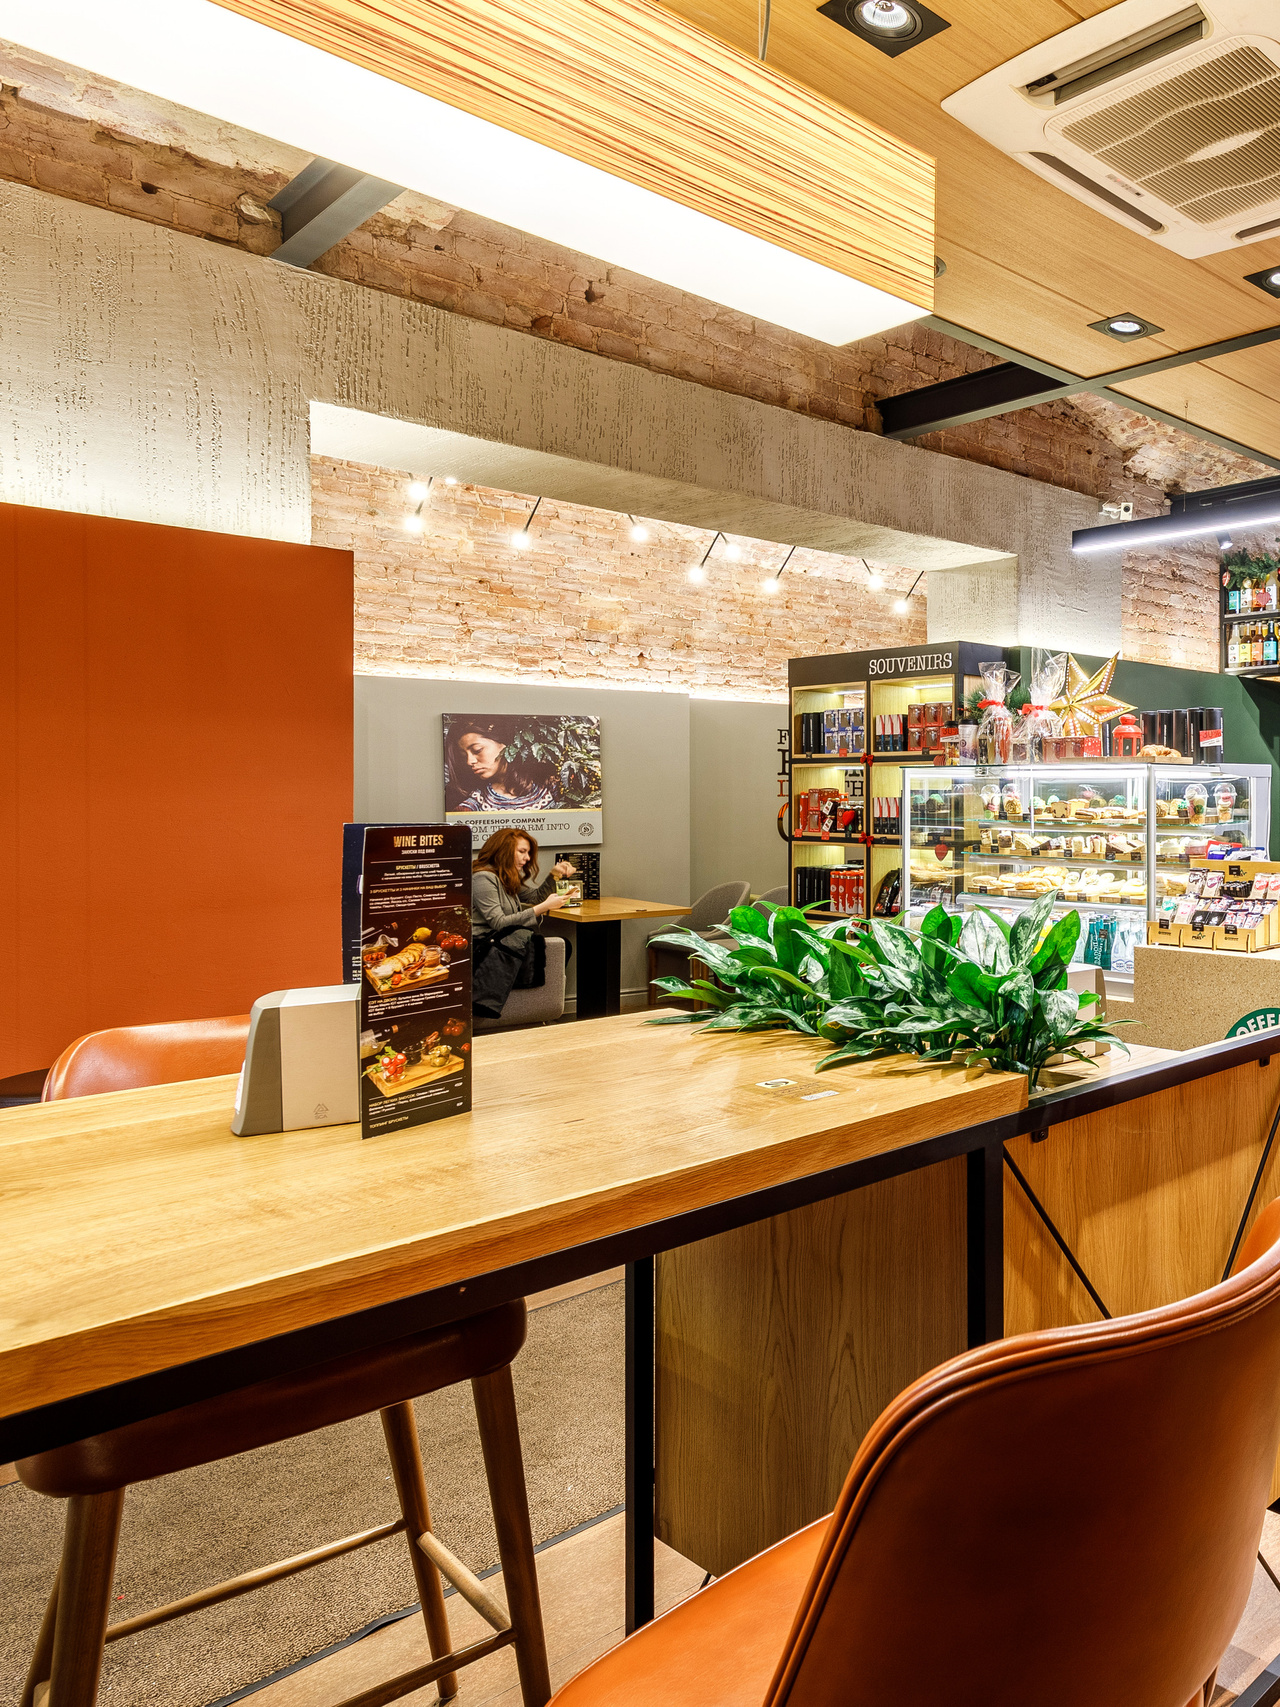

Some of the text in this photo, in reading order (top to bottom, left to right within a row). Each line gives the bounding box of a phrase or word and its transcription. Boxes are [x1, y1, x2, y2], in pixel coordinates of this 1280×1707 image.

[869, 653, 952, 675] SOUVENIRS
[472, 825, 488, 834] OM
[393, 835, 444, 847] WINE BITES
